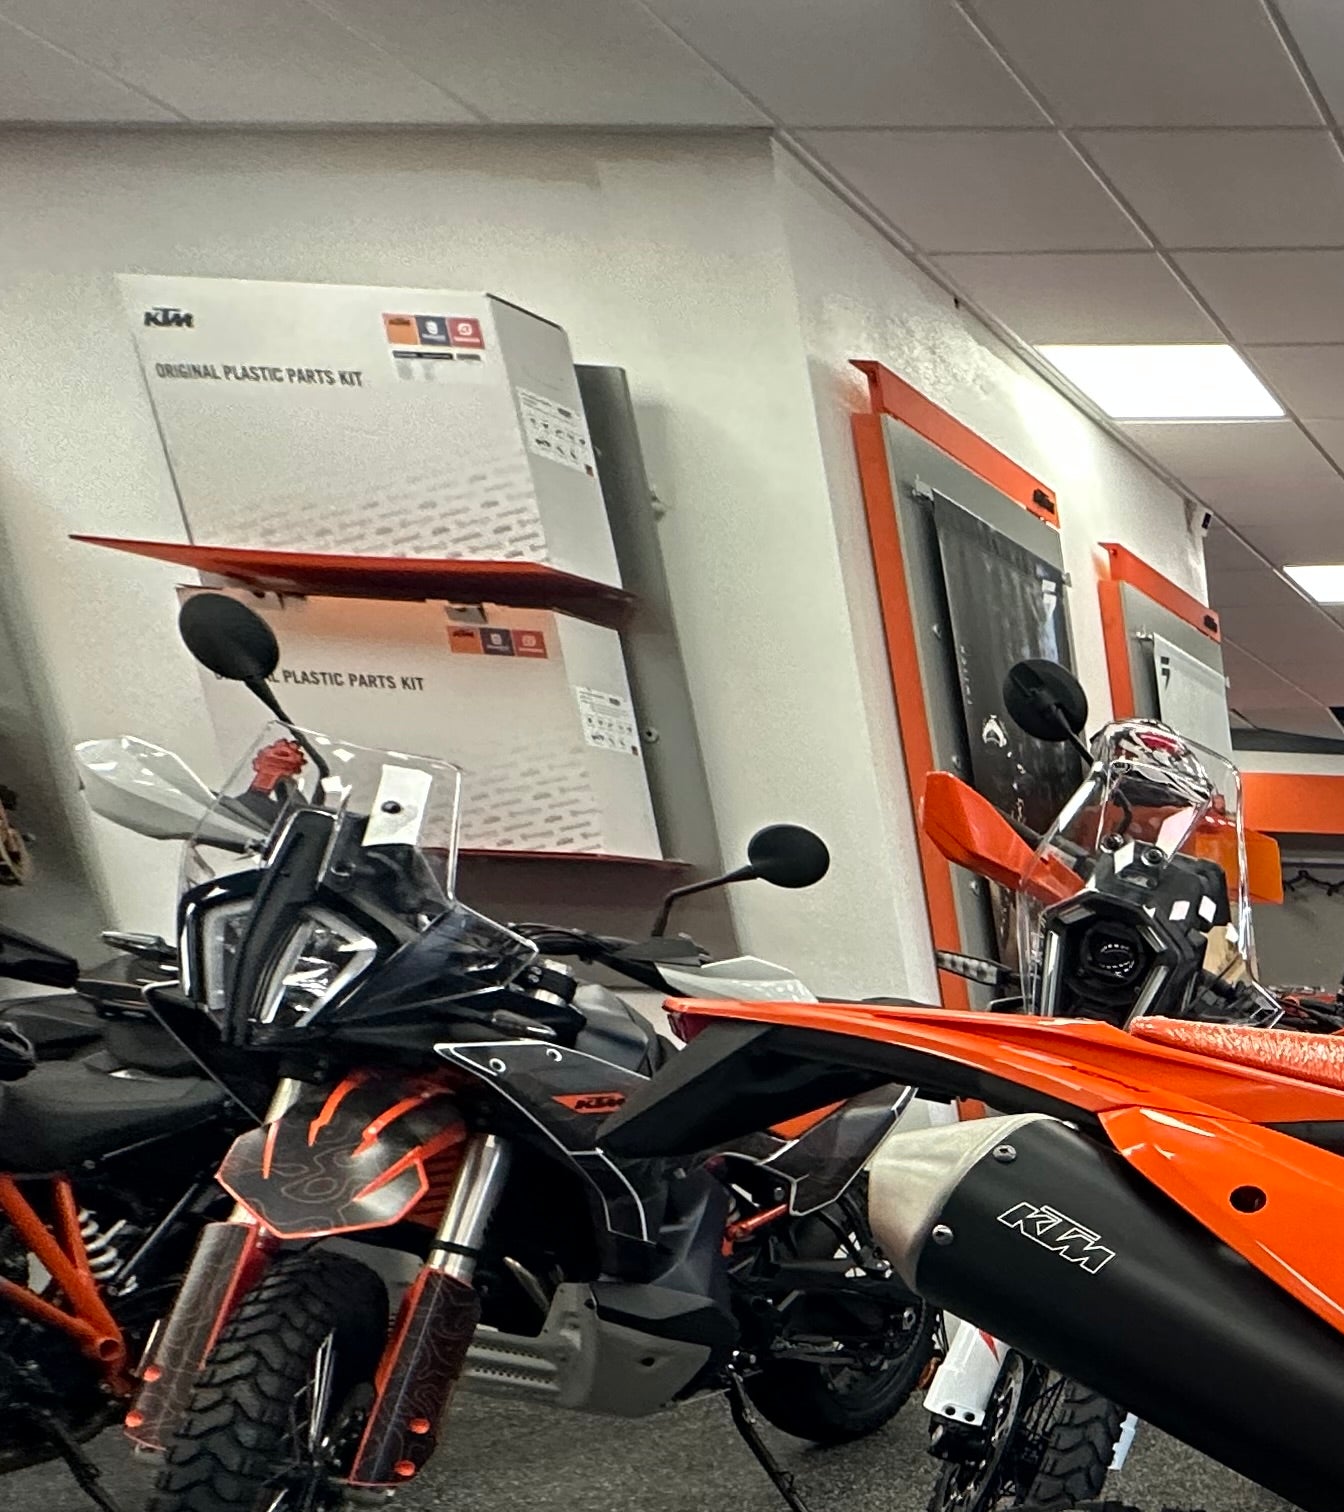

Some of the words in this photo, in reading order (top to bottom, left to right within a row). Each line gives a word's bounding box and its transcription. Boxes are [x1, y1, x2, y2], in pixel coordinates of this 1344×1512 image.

[143, 307, 195, 328] KTM
[155, 362, 221, 380] ORIGINAL
[223, 364, 284, 383] PLASTIC
[287, 367, 336, 386] PARTS
[339, 370, 364, 388] KIT
[282, 669, 346, 687] PLASTIC
[348, 672, 397, 689] PARTS
[401, 676, 425, 691] KIT
[997, 1201, 1116, 1274] KTM
